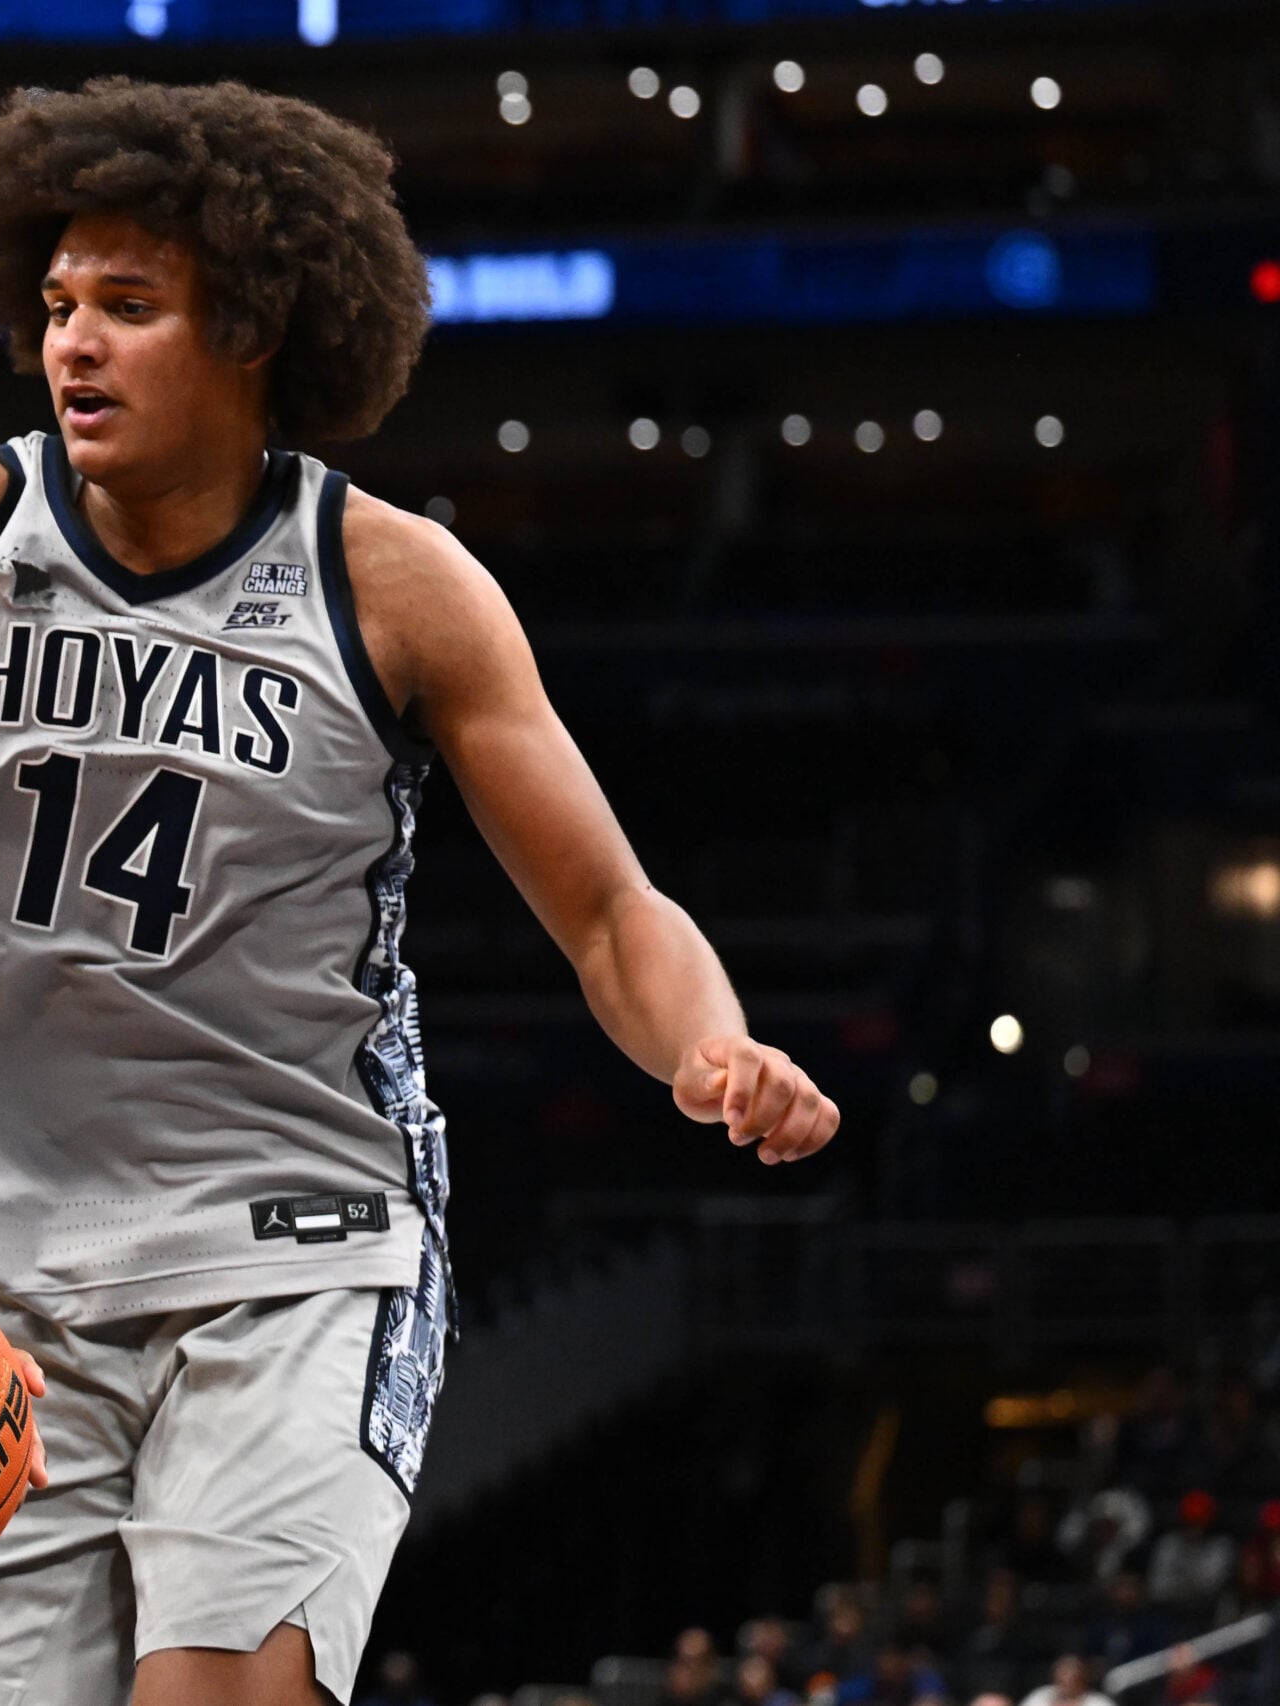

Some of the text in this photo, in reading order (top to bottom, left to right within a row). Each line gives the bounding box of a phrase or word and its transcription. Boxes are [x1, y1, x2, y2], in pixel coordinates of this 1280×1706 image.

[250, 563, 305, 580] BE THE
[243, 577, 306, 595] CHANGE
[233, 602, 280, 614] BIG
[226, 614, 292, 626] EAST
[10, 747, 208, 960] 14
[347, 1203, 369, 1219] 52
